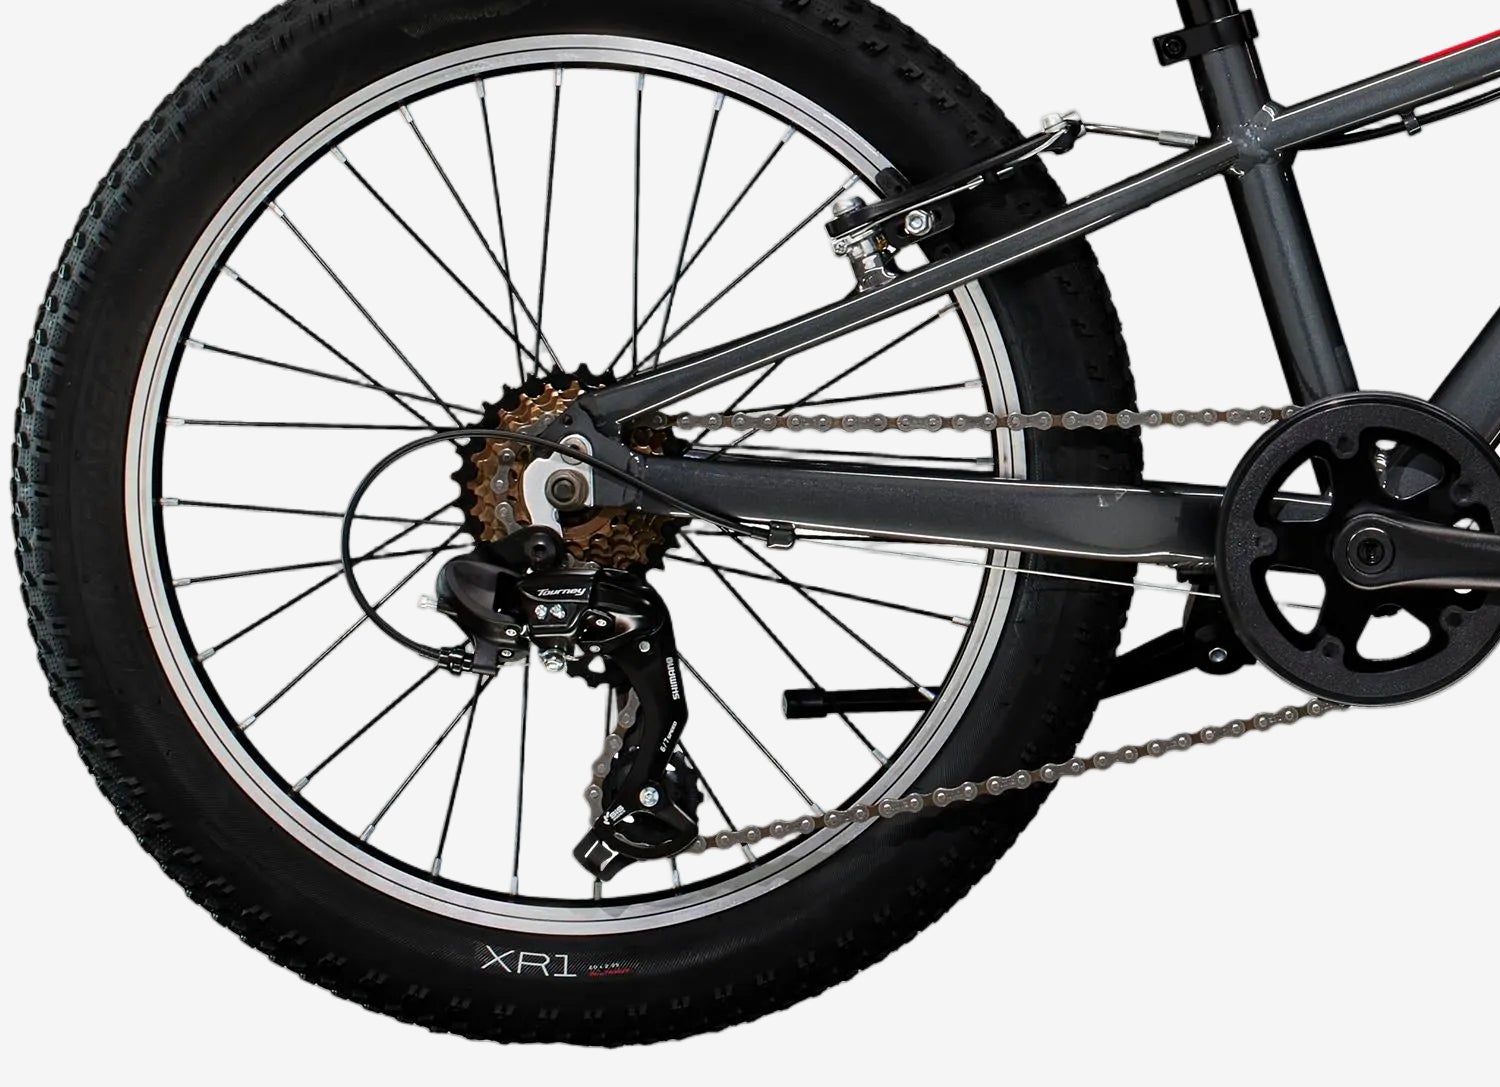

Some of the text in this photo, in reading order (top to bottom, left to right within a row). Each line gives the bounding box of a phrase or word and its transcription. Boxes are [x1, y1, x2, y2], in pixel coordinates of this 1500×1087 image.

[537, 587, 587, 597] Tourney
[665, 656, 680, 700] SHIMANO
[480, 944, 577, 978] XR1
